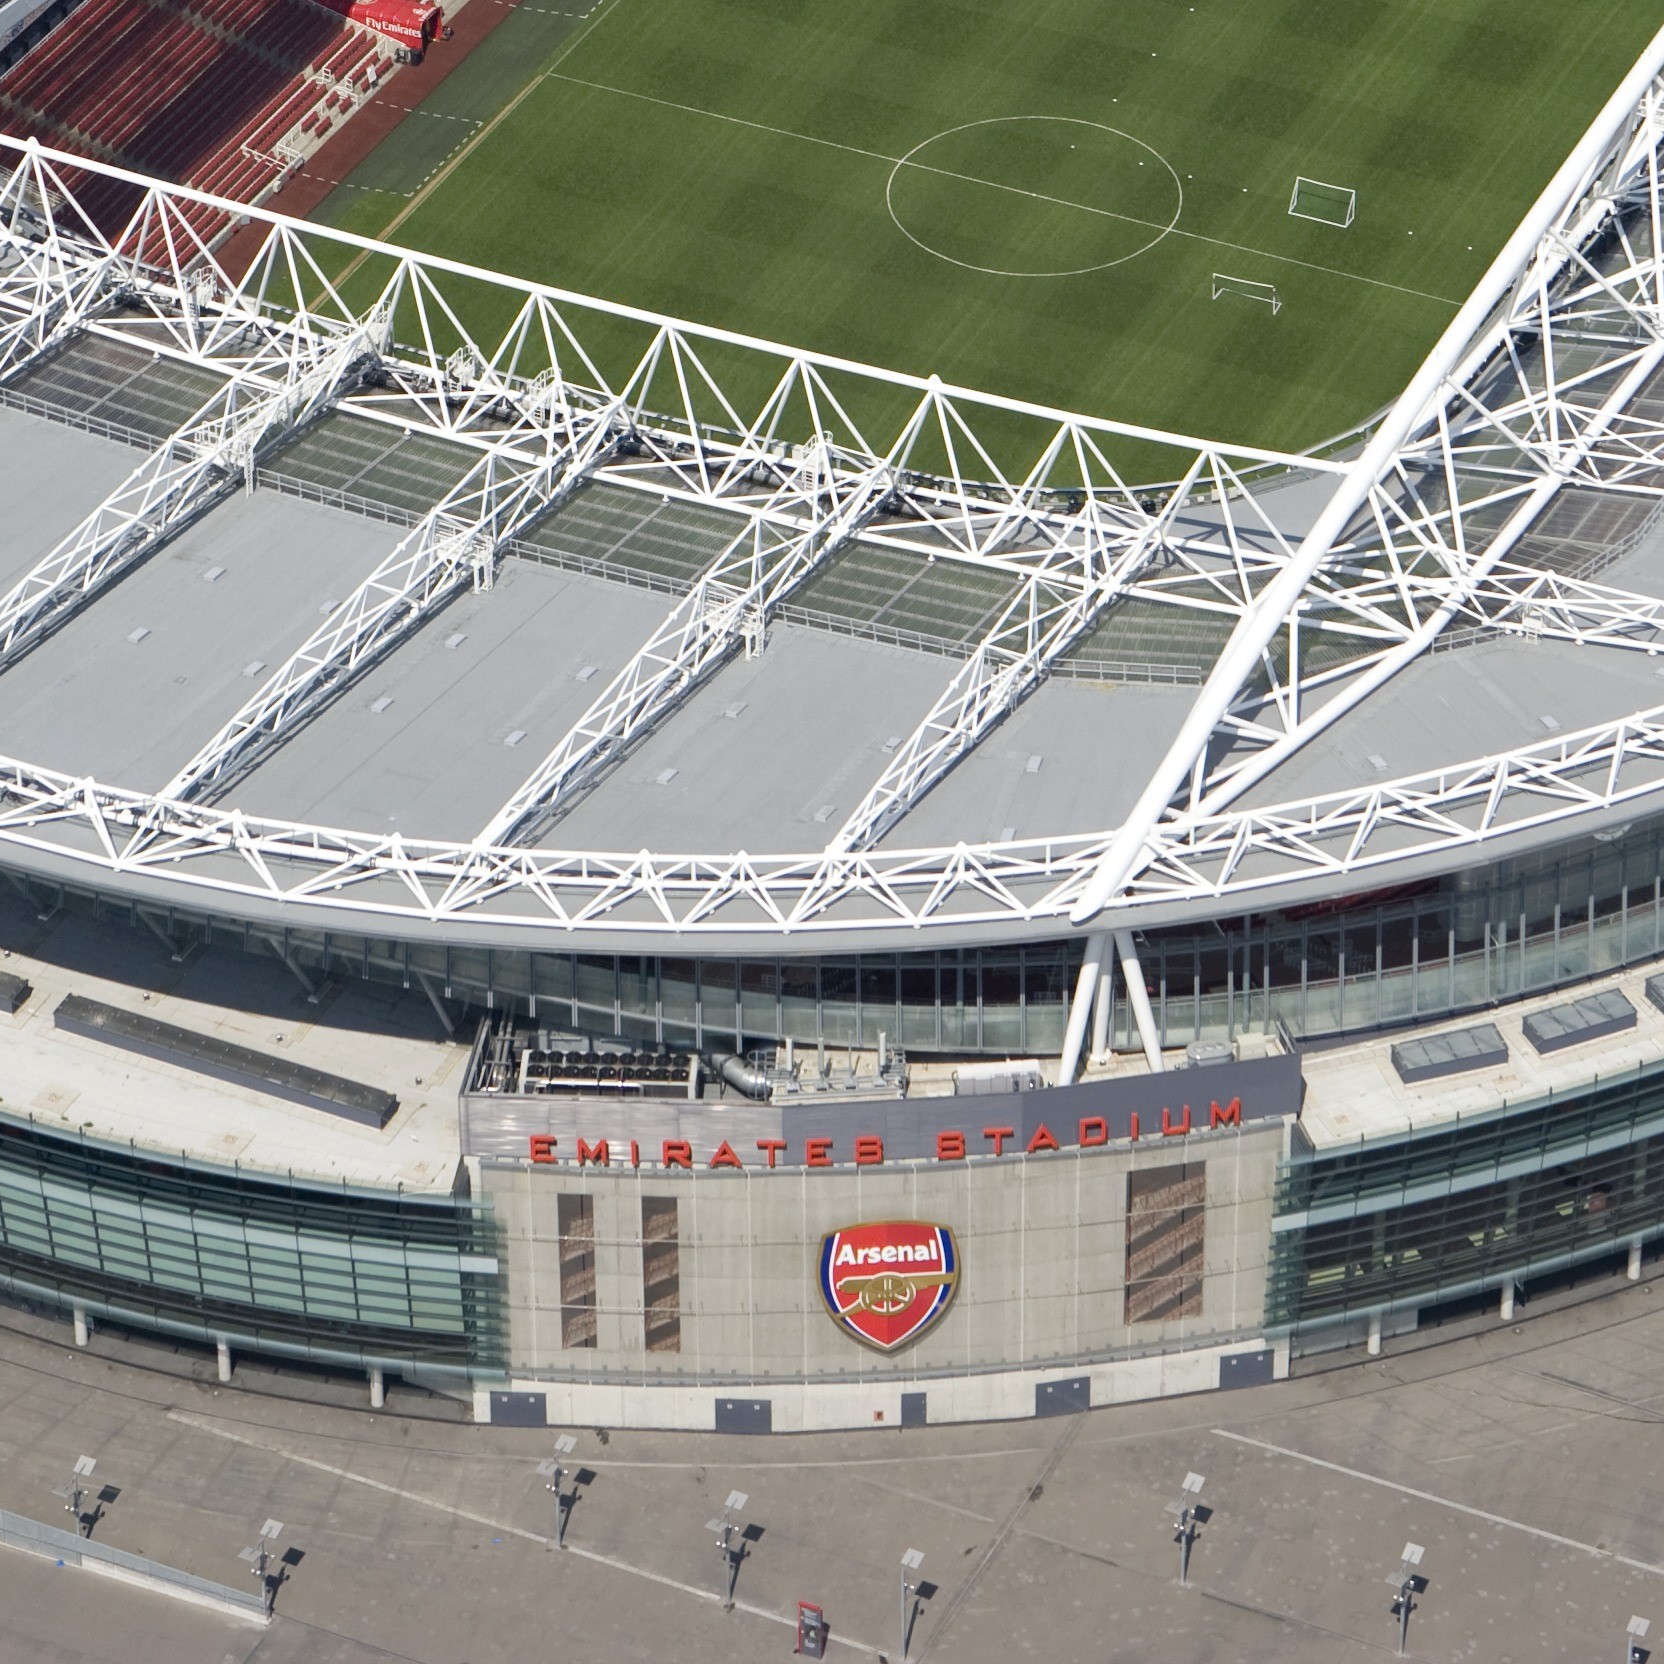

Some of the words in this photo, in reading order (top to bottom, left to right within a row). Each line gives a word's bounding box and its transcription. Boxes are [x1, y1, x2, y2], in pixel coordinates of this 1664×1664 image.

[365, 17, 382, 31] Fly
[383, 21, 421, 38] Emirates
[529, 1134, 885, 1169] EMIRATES
[936, 1096, 1241, 1160] STADIUM
[836, 1239, 938, 1266] Arsenal
